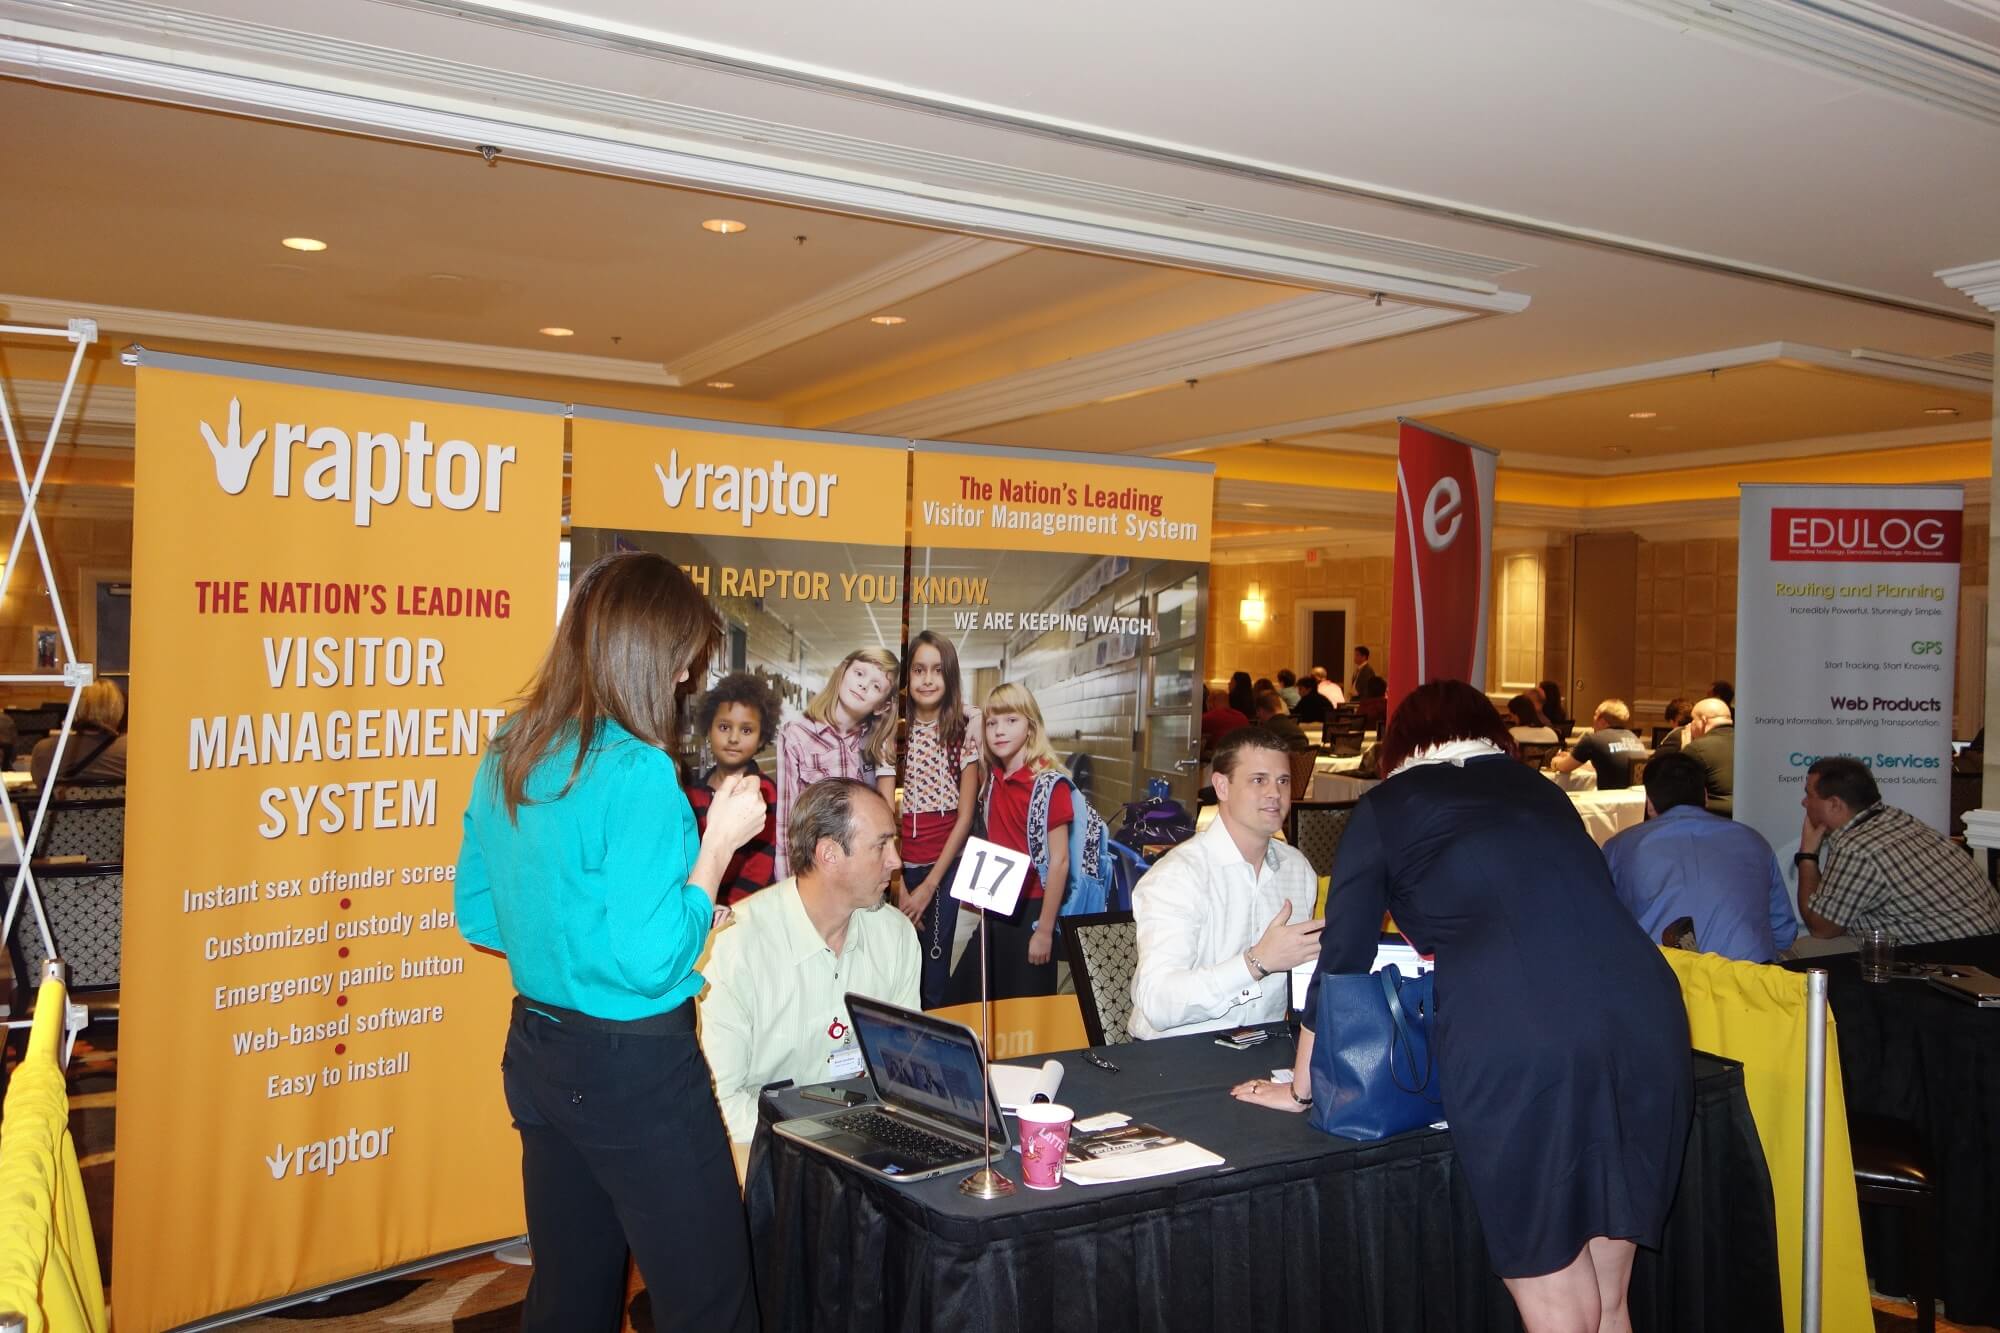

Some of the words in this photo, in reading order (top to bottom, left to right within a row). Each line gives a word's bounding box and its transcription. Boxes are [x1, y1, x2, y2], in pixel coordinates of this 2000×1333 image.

[273, 420, 516, 527] raptor
[694, 459, 838, 527] raptor
[960, 475, 993, 501] The
[1000, 478, 1077, 506] Nation's
[1084, 484, 1163, 517] Leading
[923, 501, 984, 528] Visitor
[991, 504, 1118, 536] Management
[1125, 513, 1198, 542] System
[1789, 517, 1945, 549] EDULOG
[195, 581, 249, 614] THE
[259, 582, 387, 615] NATION'S
[396, 586, 511, 619] LEADING
[720, 566, 831, 601] RAPTOR
[839, 572, 897, 605] YOU
[912, 575, 990, 606] KNOW.
[1775, 582, 1835, 600] Routing
[1839, 583, 1873, 598] and
[1877, 583, 1945, 601] Planning
[954, 612, 979, 631] WE
[983, 612, 1014, 631] ARE
[1019, 613, 1088, 633] KEEPING
[1093, 615, 1156, 636] WATCH.
[1790, 606, 1830, 616] Incredibly
[1871, 606, 1913, 617] Stunningly
[263, 637, 445, 688] VISITOR
[1824, 661, 1843, 670] Start
[1883, 661, 1902, 670] Start
[1911, 641, 1943, 655] GPS
[1754, 716, 1785, 727] Sharing
[1836, 717, 1879, 728] Simplifying
[1830, 696, 1868, 711] Web
[1872, 697, 1942, 712] Products
[188, 708, 506, 771] MANAGEMENT
[1778, 774, 1803, 785] Expert
[1876, 753, 1940, 769] Services
[257, 778, 438, 839] SYSTEM
[183, 881, 259, 914] Instant
[266, 878, 302, 901] sex
[309, 865, 395, 896] offender
[401, 862, 456, 885] scree
[969, 850, 1015, 897] 17
[204, 920, 328, 961] Customized
[335, 910, 413, 940] custody
[419, 906, 455, 930] aler
[215, 972, 333, 1012] Emergency
[339, 958, 394, 992] panic
[400, 953, 464, 978] button
[232, 1012, 349, 1057] Web-based
[356, 1004, 444, 1035] software
[267, 1067, 316, 1100] Easy
[321, 1063, 342, 1088] to
[347, 1052, 410, 1081] install
[295, 1123, 395, 1177] raptor
[1038, 1127, 1066, 1153] LATTE
